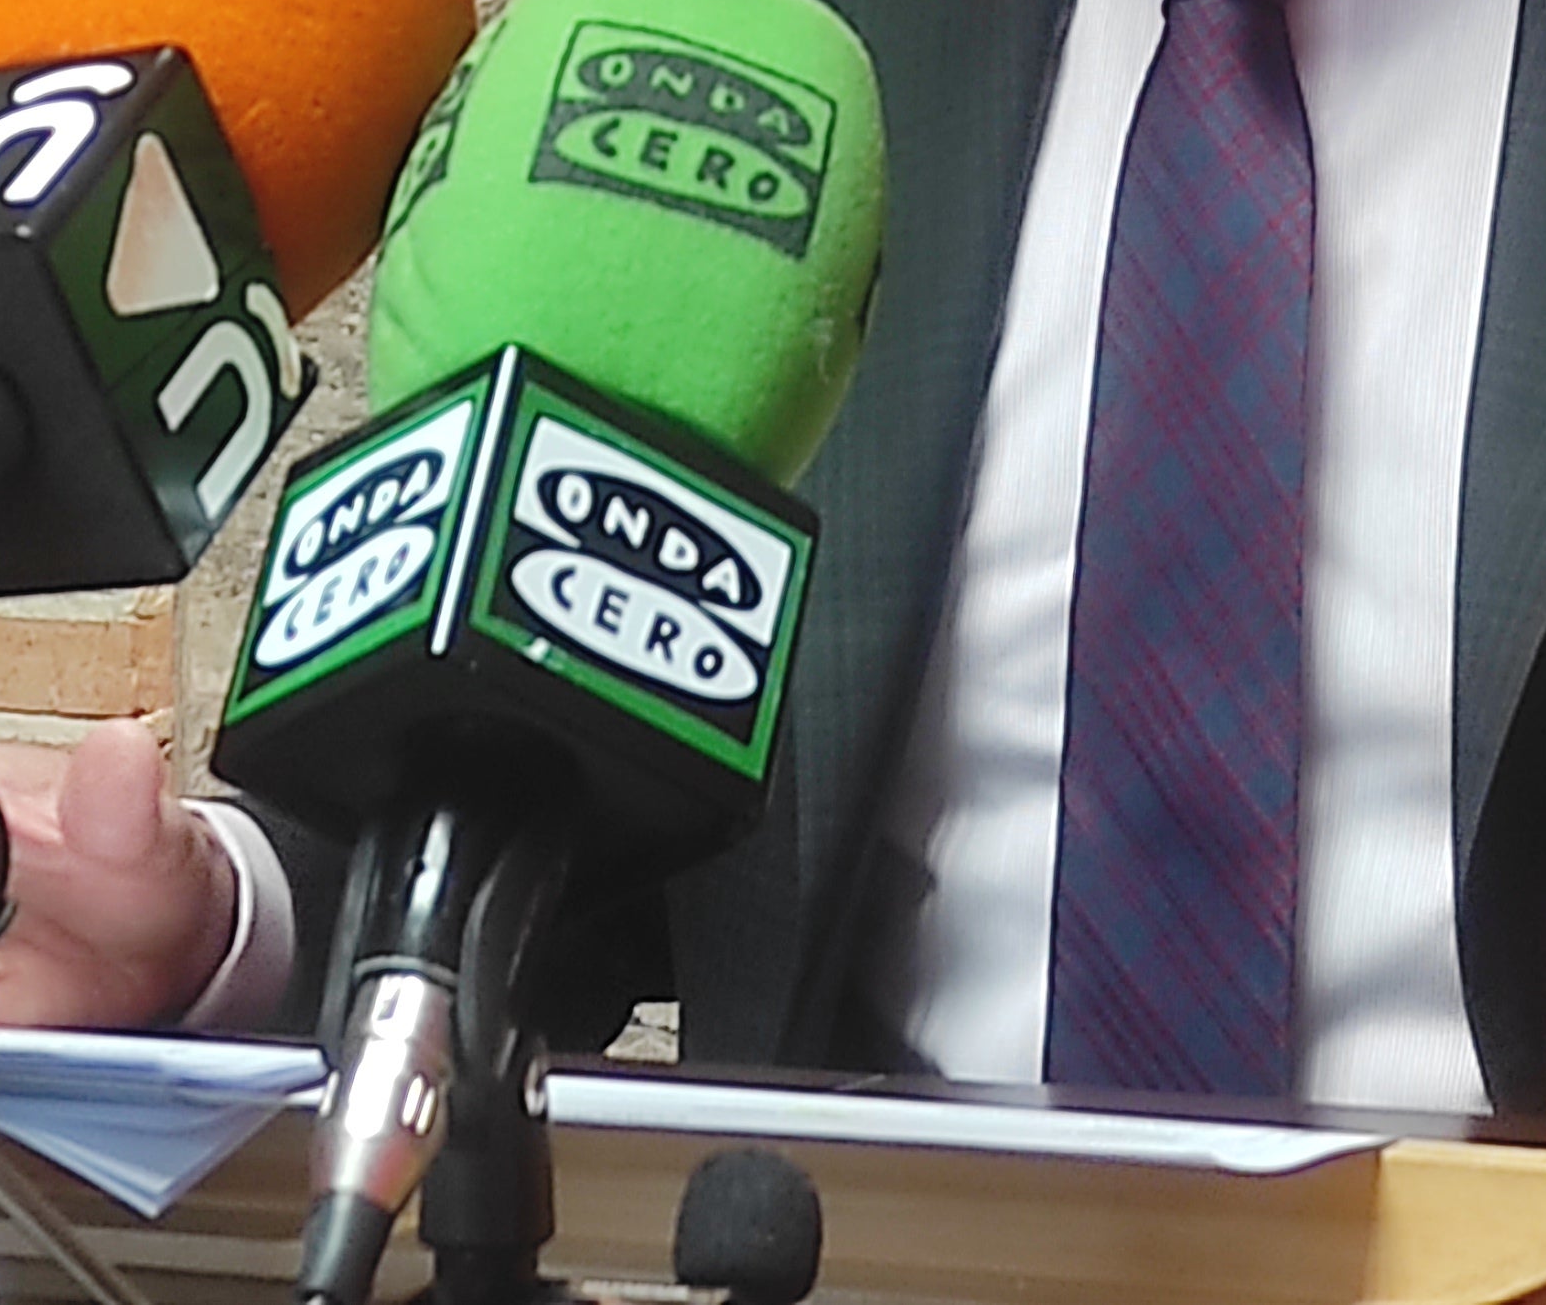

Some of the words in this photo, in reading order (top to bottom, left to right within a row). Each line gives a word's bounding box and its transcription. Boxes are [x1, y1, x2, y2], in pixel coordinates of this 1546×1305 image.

[599, 54, 791, 136] ONDA
[591, 117, 781, 202] CERO
[295, 458, 431, 567] ONDA
[555, 473, 741, 604] ONDA
[283, 542, 411, 642] CERO
[551, 565, 725, 680] CERO
